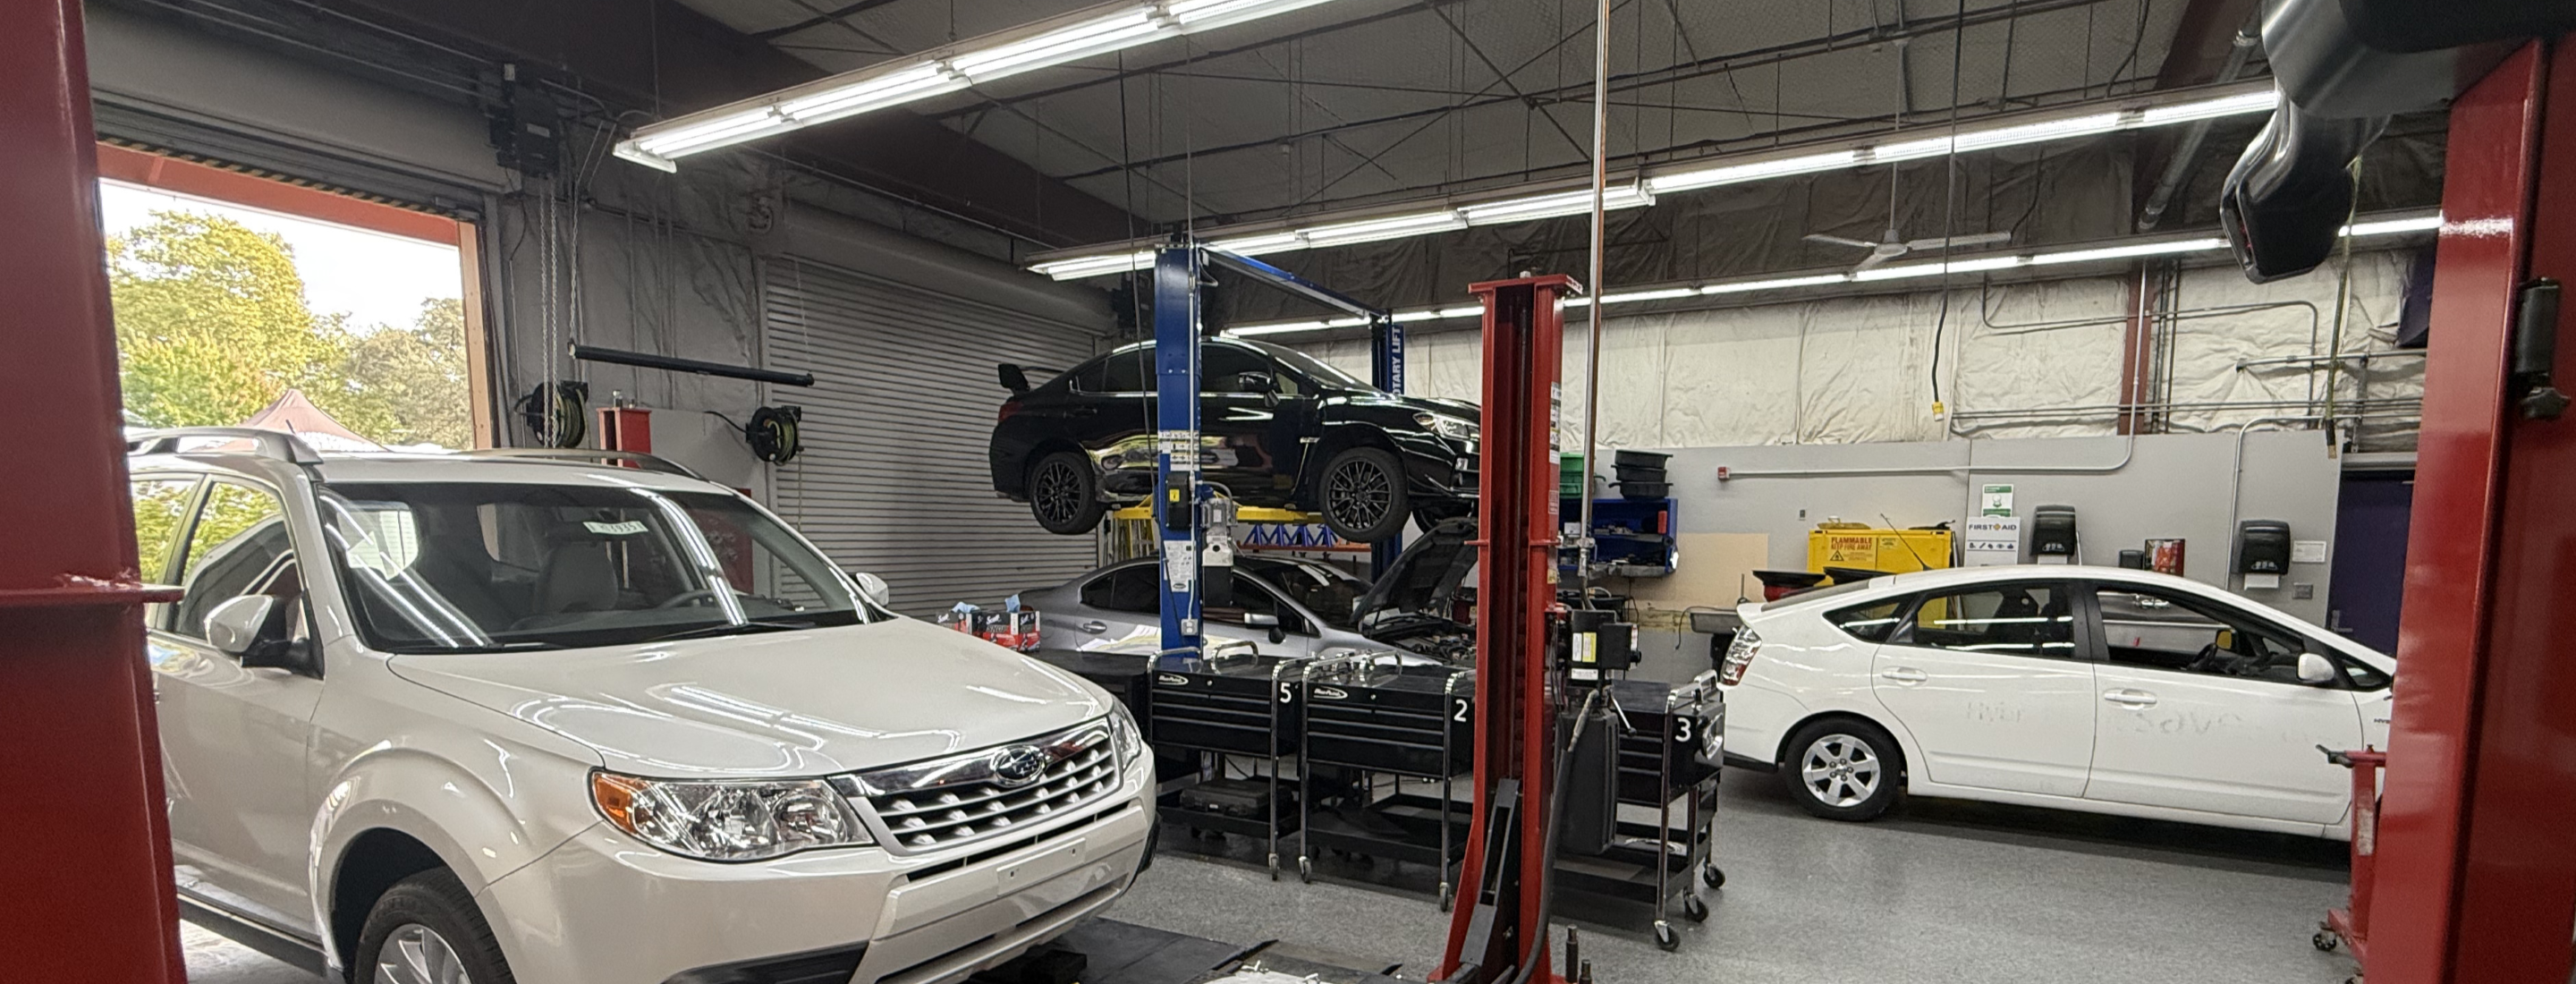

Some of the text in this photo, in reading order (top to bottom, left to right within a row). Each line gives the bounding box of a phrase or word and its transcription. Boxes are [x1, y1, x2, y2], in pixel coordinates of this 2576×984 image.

[1392, 327, 1402, 394] OTARY LIFT
[1280, 683, 1292, 703] 5
[1453, 699, 1468, 722] 2
[1675, 717, 1691, 742] 3
